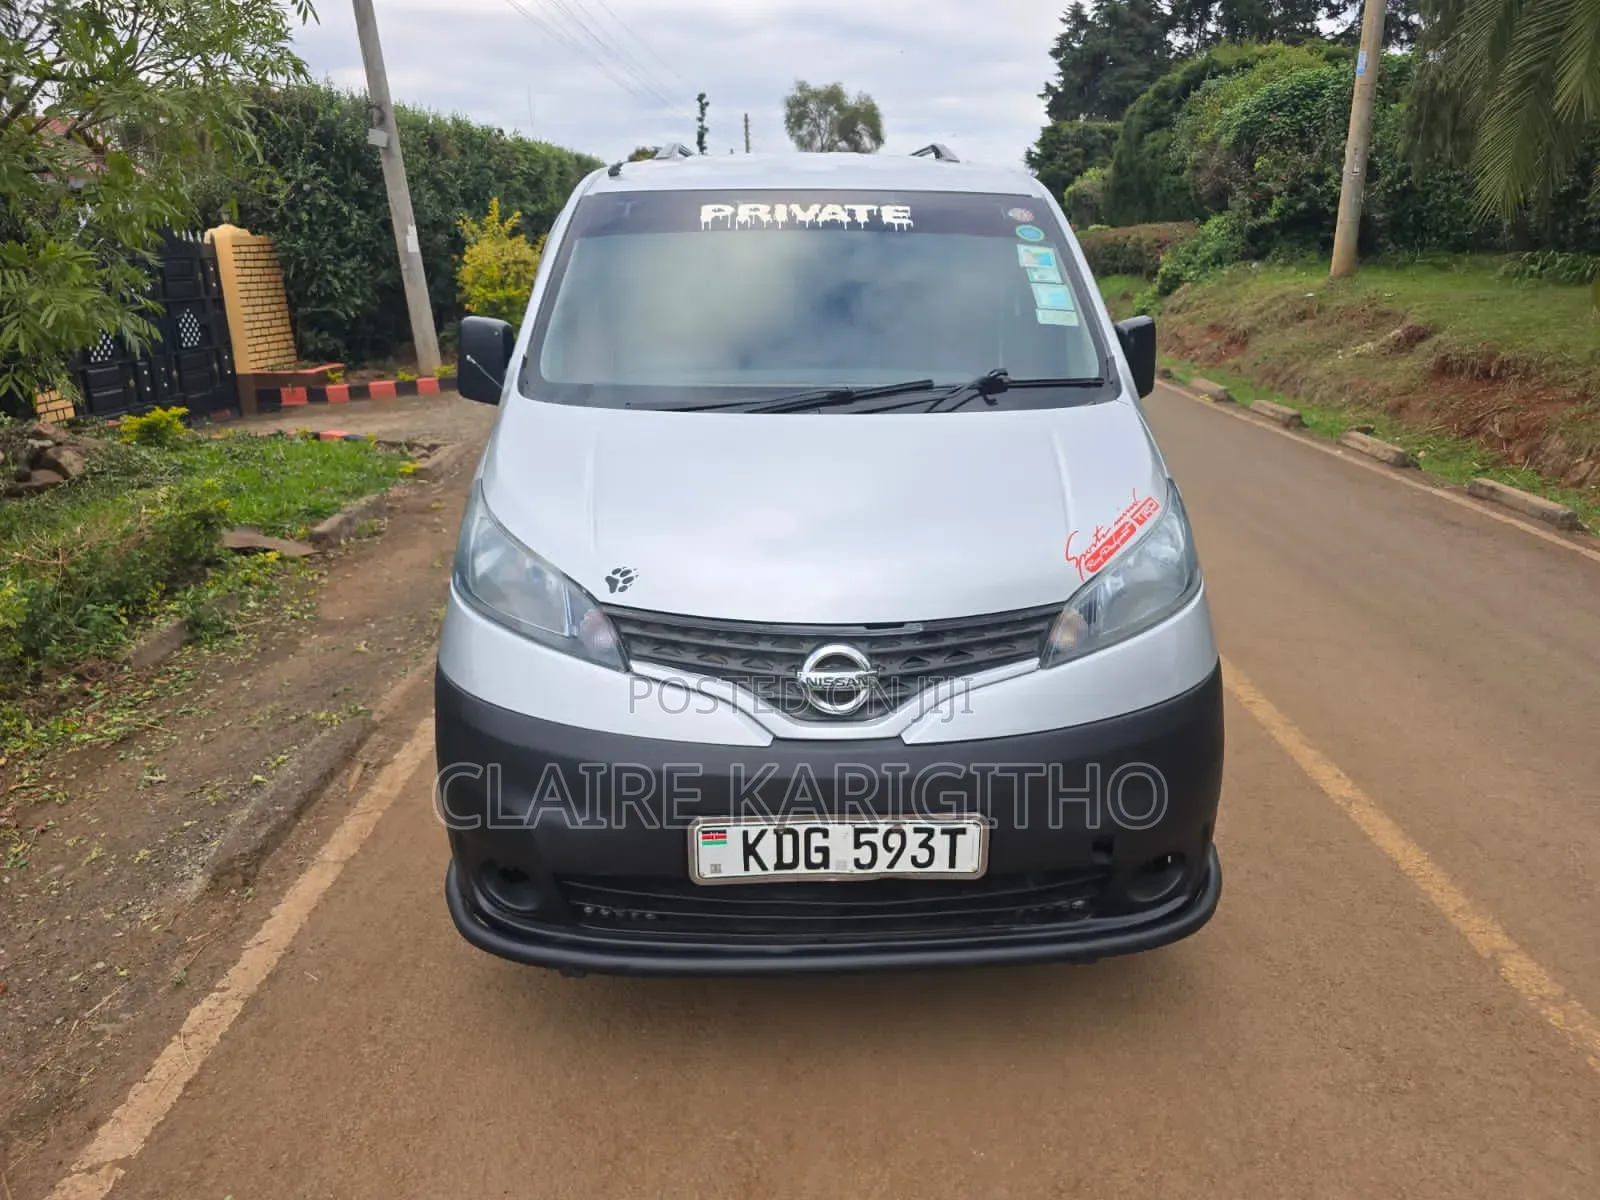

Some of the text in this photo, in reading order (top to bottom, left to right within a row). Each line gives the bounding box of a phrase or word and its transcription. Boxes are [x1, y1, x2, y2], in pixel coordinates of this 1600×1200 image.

[700, 204, 914, 231] PRIVATE
[806, 676, 868, 688] NISSAN
[742, 826, 967, 872] KDG 593T
